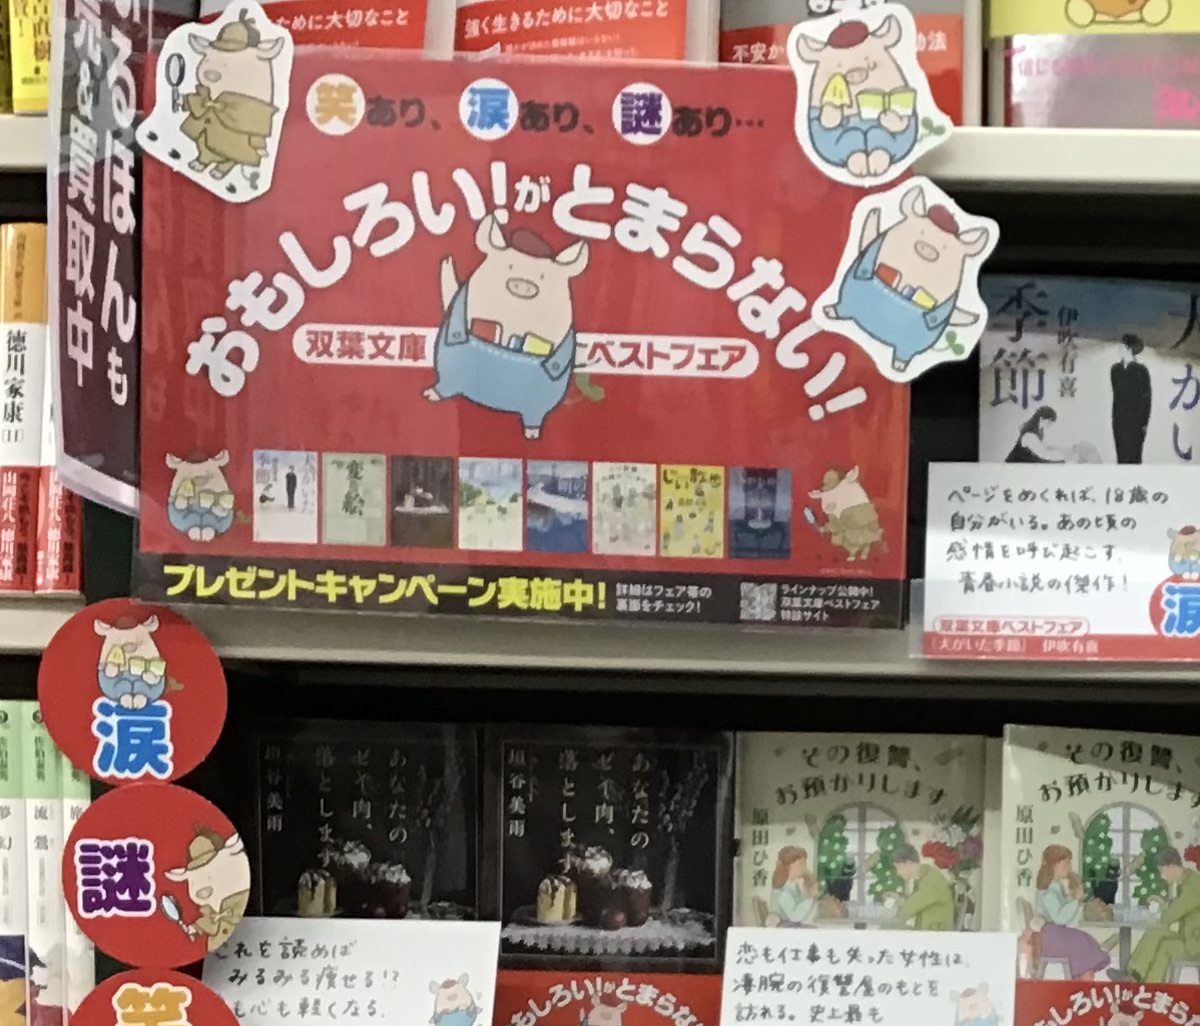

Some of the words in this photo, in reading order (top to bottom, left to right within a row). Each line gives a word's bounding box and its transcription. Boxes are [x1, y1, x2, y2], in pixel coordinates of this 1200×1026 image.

[101, 0, 140, 406] るほんも
[94, 700, 171, 777] 涙
[78, 841, 153, 915] 謎
